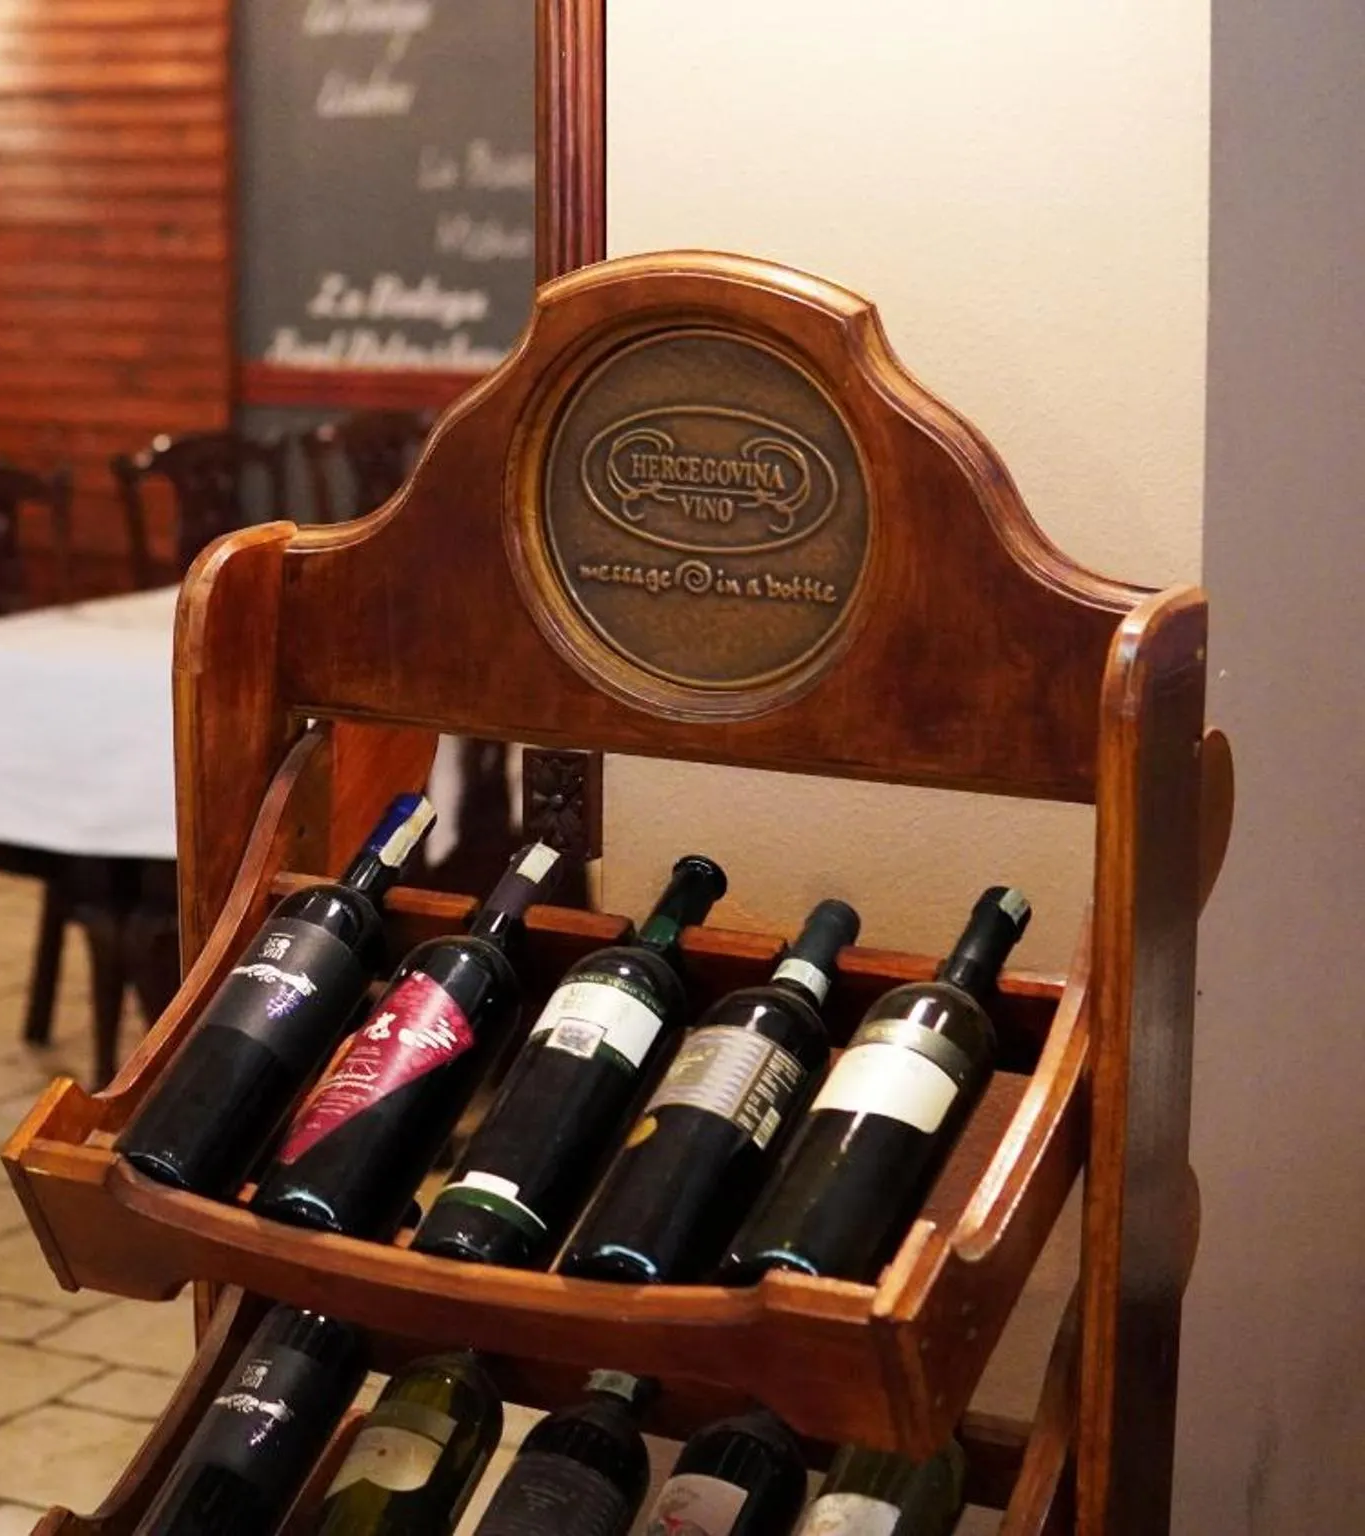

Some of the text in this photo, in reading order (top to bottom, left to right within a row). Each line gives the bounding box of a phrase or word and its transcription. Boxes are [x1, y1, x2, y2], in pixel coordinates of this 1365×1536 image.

[630, 453, 786, 490] HERCEGOVINA
[679, 495, 734, 522] VINO
[579, 562, 837, 603] message in a bottle
